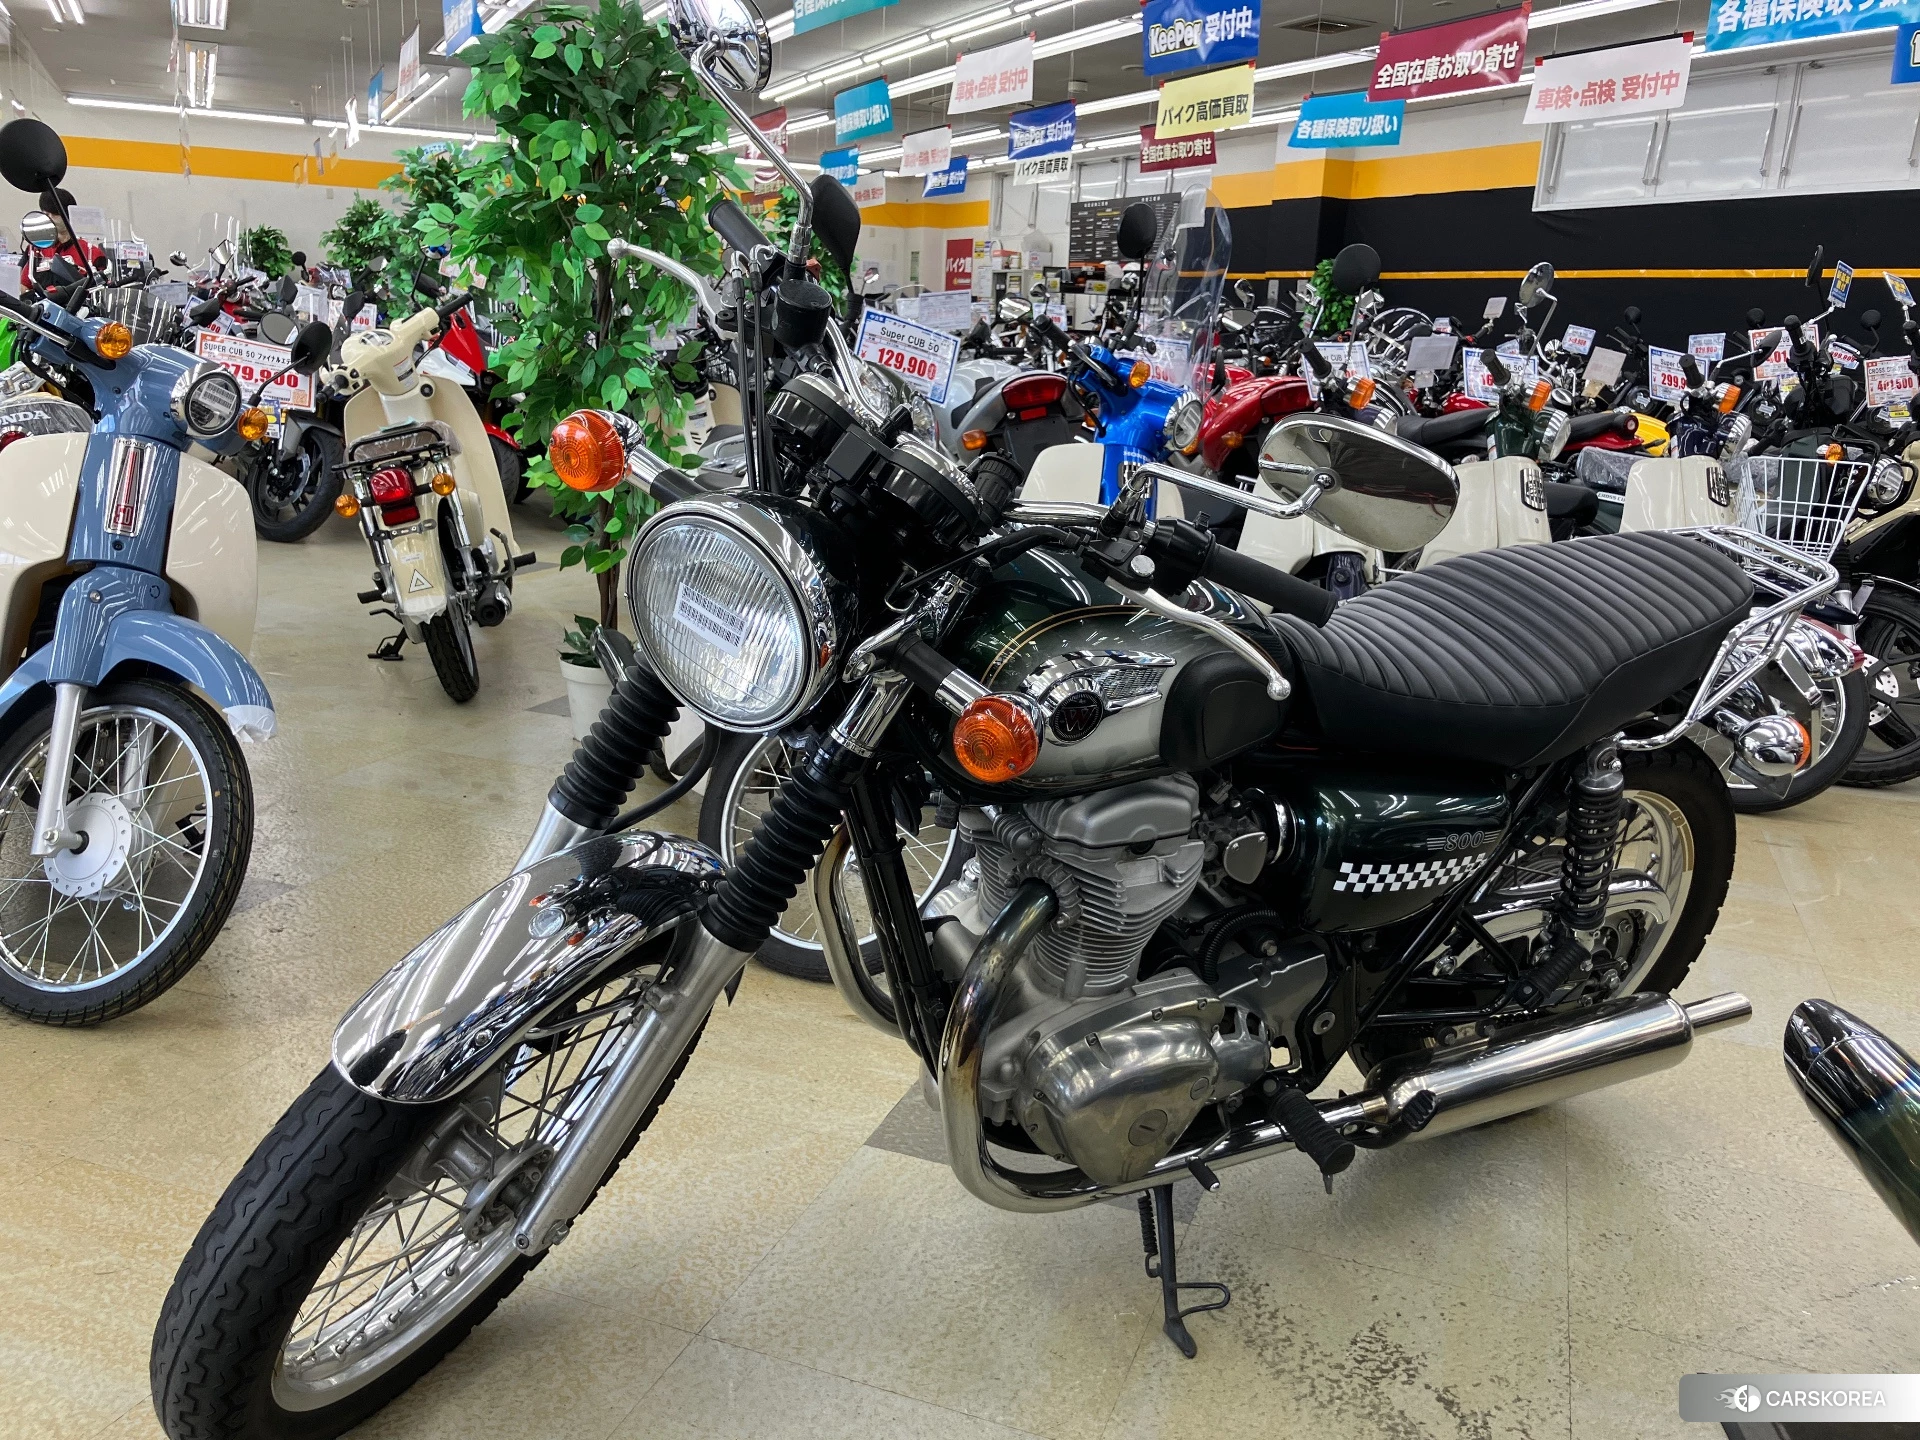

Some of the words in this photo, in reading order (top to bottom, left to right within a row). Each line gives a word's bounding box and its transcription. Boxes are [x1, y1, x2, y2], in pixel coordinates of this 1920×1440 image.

[1149, 18, 1203, 56] KeePer
[1205, 6, 1252, 44] 受付中
[1374, 41, 1519, 89] 全国在庫お取り寄せ
[998, 66, 1028, 94] 受付中
[1535, 79, 1617, 111] 車検・点検
[1621, 70, 1680, 101] 受付中
[1161, 94, 1249, 126] バイク高価買取
[1046, 121, 1073, 143] 受付中
[1297, 115, 1398, 139] 各種保険取り扱い
[1141, 138, 1212, 164] 全国在庫お取り寄せ
[1017, 156, 1069, 177] バイク高価買取
[204, 342, 226, 353] SUPER
[228, 346, 243, 356] CUB
[246, 350, 255, 359] 50
[880, 327, 906, 342] Super
[908, 335, 925, 348] CUB
[928, 342, 939, 353] 50
[877, 348, 937, 380] 129,900
[1660, 358, 1675, 367] Super
[1444, 830, 1485, 851] 800
